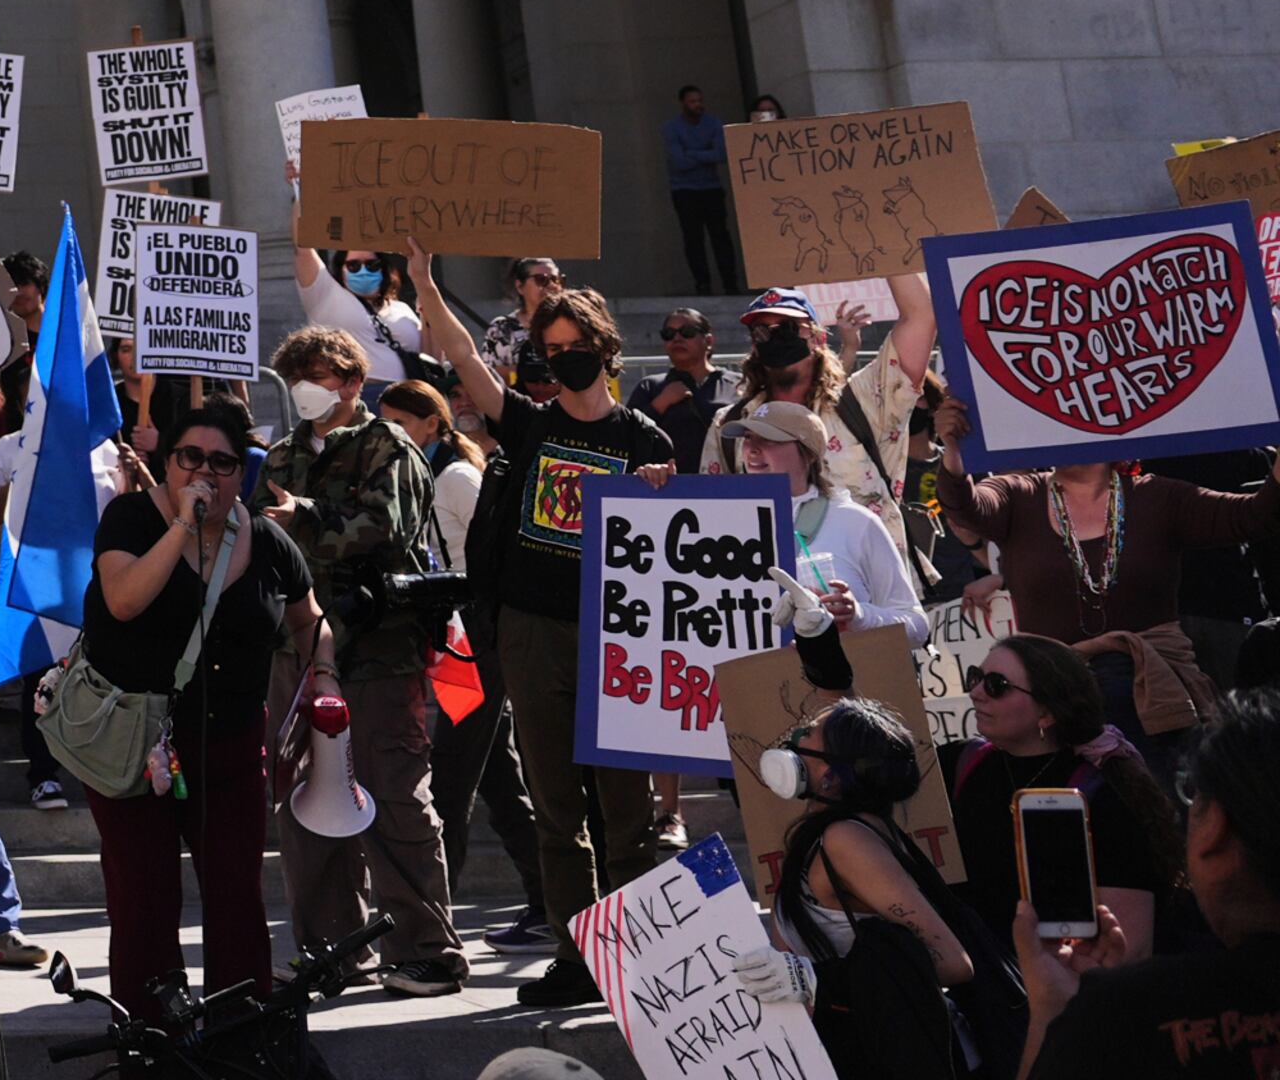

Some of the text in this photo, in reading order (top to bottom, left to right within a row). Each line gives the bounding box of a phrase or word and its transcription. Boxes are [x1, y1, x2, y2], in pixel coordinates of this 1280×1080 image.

[97, 47, 186, 76] THE WHOLE
[97, 69, 189, 88] SYSTEM
[101, 82, 189, 114] IS GUILTY
[110, 126, 191, 165] DOWN!
[739, 131, 953, 185] FICTION AGAIN
[750, 115, 932, 158] MAKE ORWELL
[329, 139, 393, 193] ICE
[399, 142, 489, 187] OUT
[500, 145, 558, 192] OF
[357, 196, 557, 241] EVERYWHERE
[146, 232, 248, 255] ¡EL PUEBLO
[155, 251, 239, 280] UNIDO
[149, 276, 245, 299] DEFENDERÁ
[978, 277, 1047, 329] ICE
[1089, 275, 1132, 322] NO
[143, 306, 153, 326] A
[155, 306, 183, 329] LAS
[185, 307, 251, 333] FAMILIAS
[148, 328, 247, 355] INMIGRANTES
[986, 286, 1236, 394] FOR OUR WARM
[1054, 349, 1193, 428] HEARTS
[605, 506, 776, 582] Be Good
[602, 580, 774, 651] Be Pretti
[602, 642, 653, 705] Be
[596, 874, 701, 973] MAKE
[664, 988, 762, 1076] AFRAID
